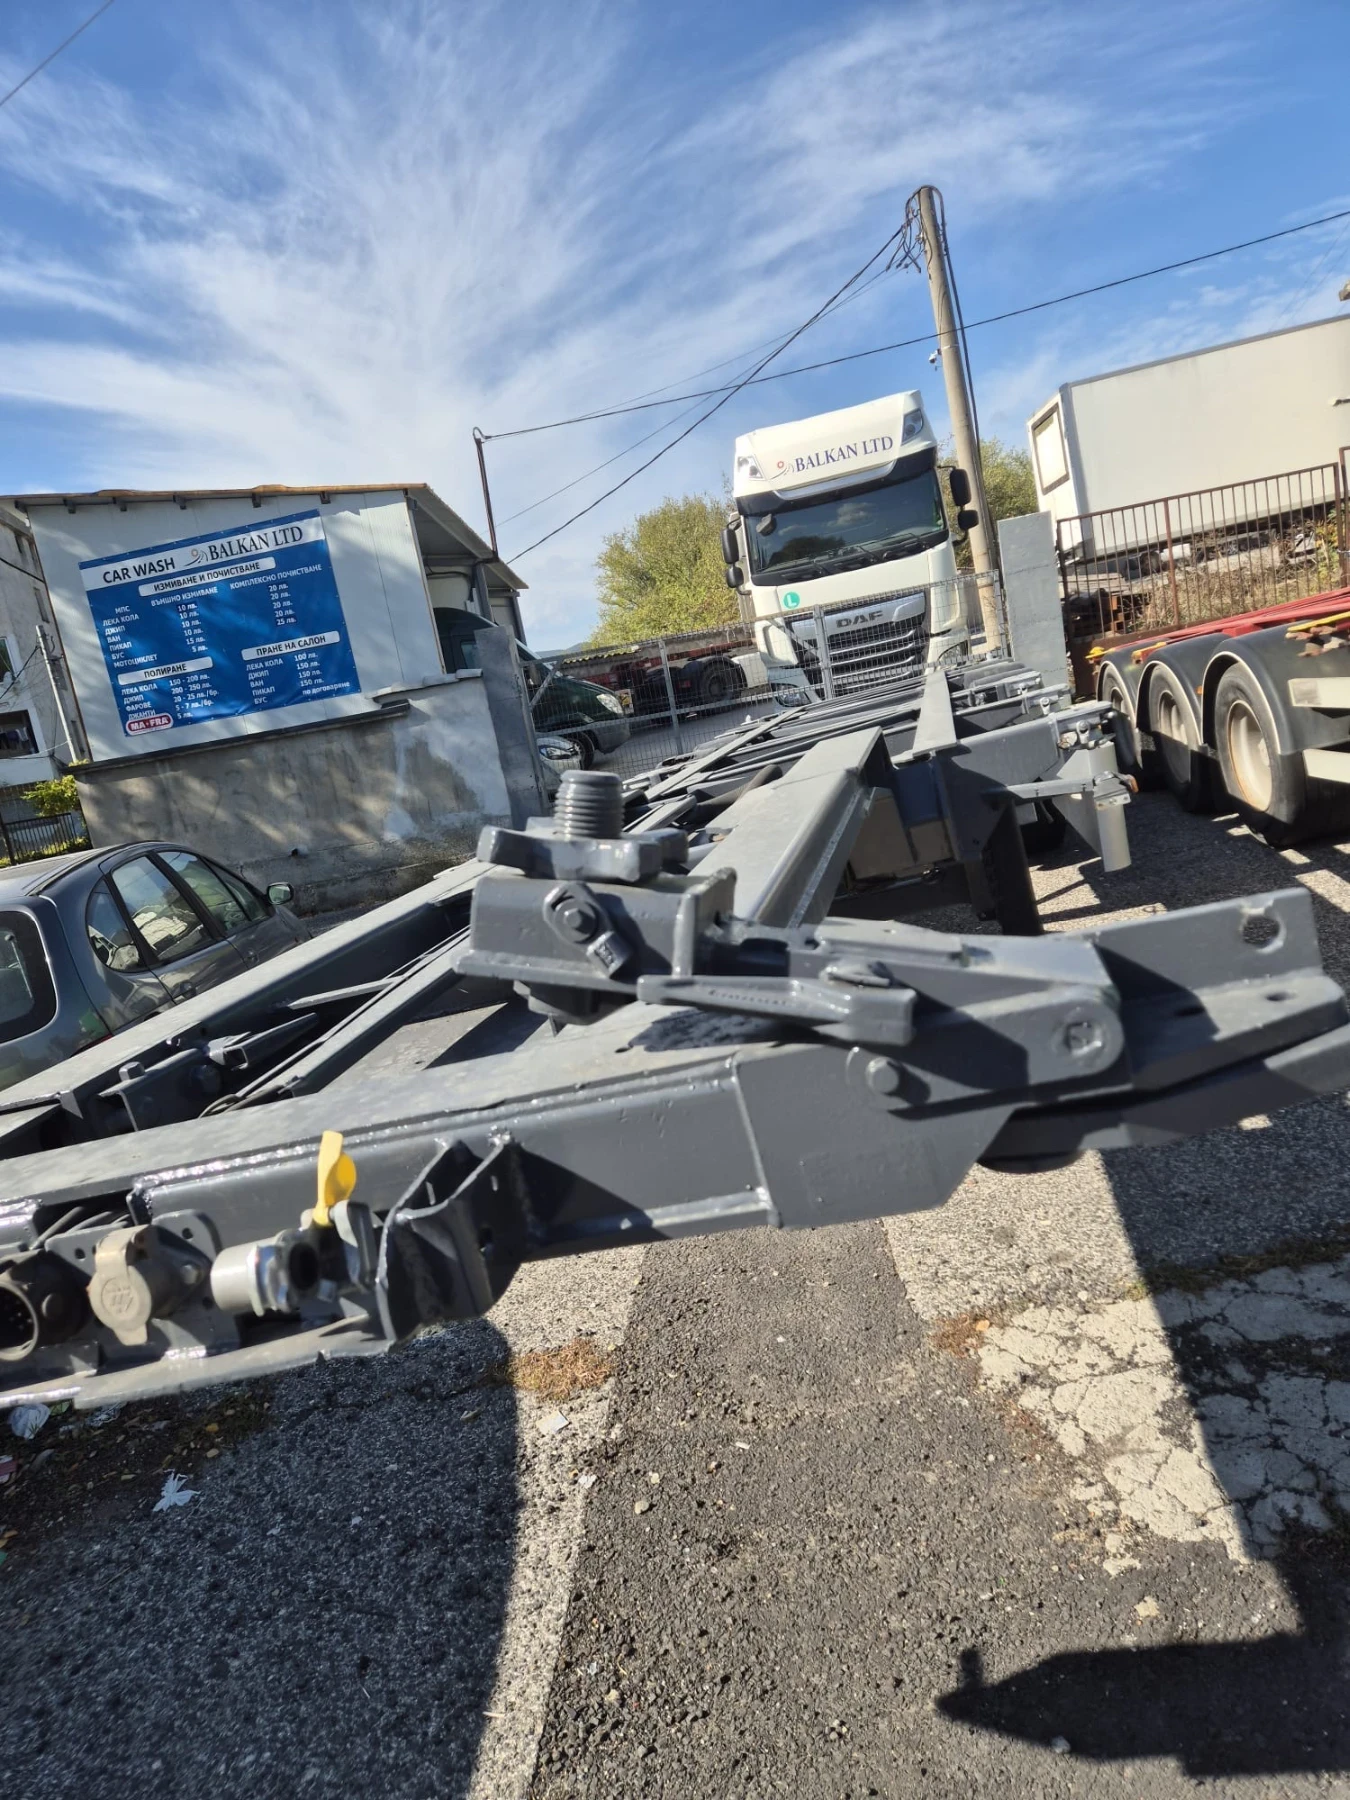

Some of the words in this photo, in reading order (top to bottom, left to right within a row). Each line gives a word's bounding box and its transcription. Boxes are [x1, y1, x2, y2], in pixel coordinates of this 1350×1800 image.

[794, 443, 859, 473] BALKAN
[862, 435, 894, 456] LTD
[208, 532, 270, 561] BALKAN
[271, 526, 303, 547] LTD
[102, 567, 131, 583] CAR
[133, 557, 176, 577] WASH
[153, 576, 198, 592] ИЗМИВАНЕ
[199, 573, 206, 581] И
[207, 562, 260, 580] ПОЧИСТВАНЕ
[229, 574, 277, 590] КОМПЛЕКСНО
[277, 563, 322, 580] ПОЧИСТВАНЕ
[182, 586, 219, 599] ИЗМИВАНЕ
[268, 584, 277, 592] 20
[270, 592, 279, 600] 20
[115, 605, 130, 614] МПС
[178, 604, 186, 612] 10
[272, 601, 281, 609] 20
[179, 612, 188, 620] 10
[274, 610, 283, 618] 20
[102, 617, 121, 627] ЛЕКА
[121, 613, 140, 623] КОЛА
[181, 620, 190, 628] 10
[276, 618, 285, 626] 25
[836, 610, 884, 629] DAF
[105, 625, 126, 636] ДЖИП
[107, 635, 121, 643] ВАН
[186, 637, 194, 645] 15
[109, 641, 133, 652] ПИКАП
[256, 645, 283, 656] ПРАНЕ
[285, 642, 297, 650] НА
[298, 635, 326, 647] САЛОН
[111, 652, 125, 660] БУС
[113, 654, 158, 668] МОТОЦИКЛЕТ
[294, 653, 307, 661] 100
[246, 661, 264, 671] ЛЕКА
[264, 658, 284, 667] КОЛА
[296, 662, 309, 670] 150
[144, 664, 187, 679] ПОЛИРАНЕ
[248, 670, 269, 680] ДЖИП
[298, 670, 311, 678] 150
[169, 678, 181, 687] 150
[186, 675, 199, 683] 200
[250, 680, 264, 688] ВАН
[300, 679, 313, 687] 150
[121, 686, 139, 696] ЛЕКА
[139, 683, 158, 692] КОЛА
[252, 686, 275, 696] ПИКАП
[123, 694, 144, 705] ДЖИП
[254, 696, 268, 705] БУС
[125, 701, 152, 712] ФАРОВЕ
